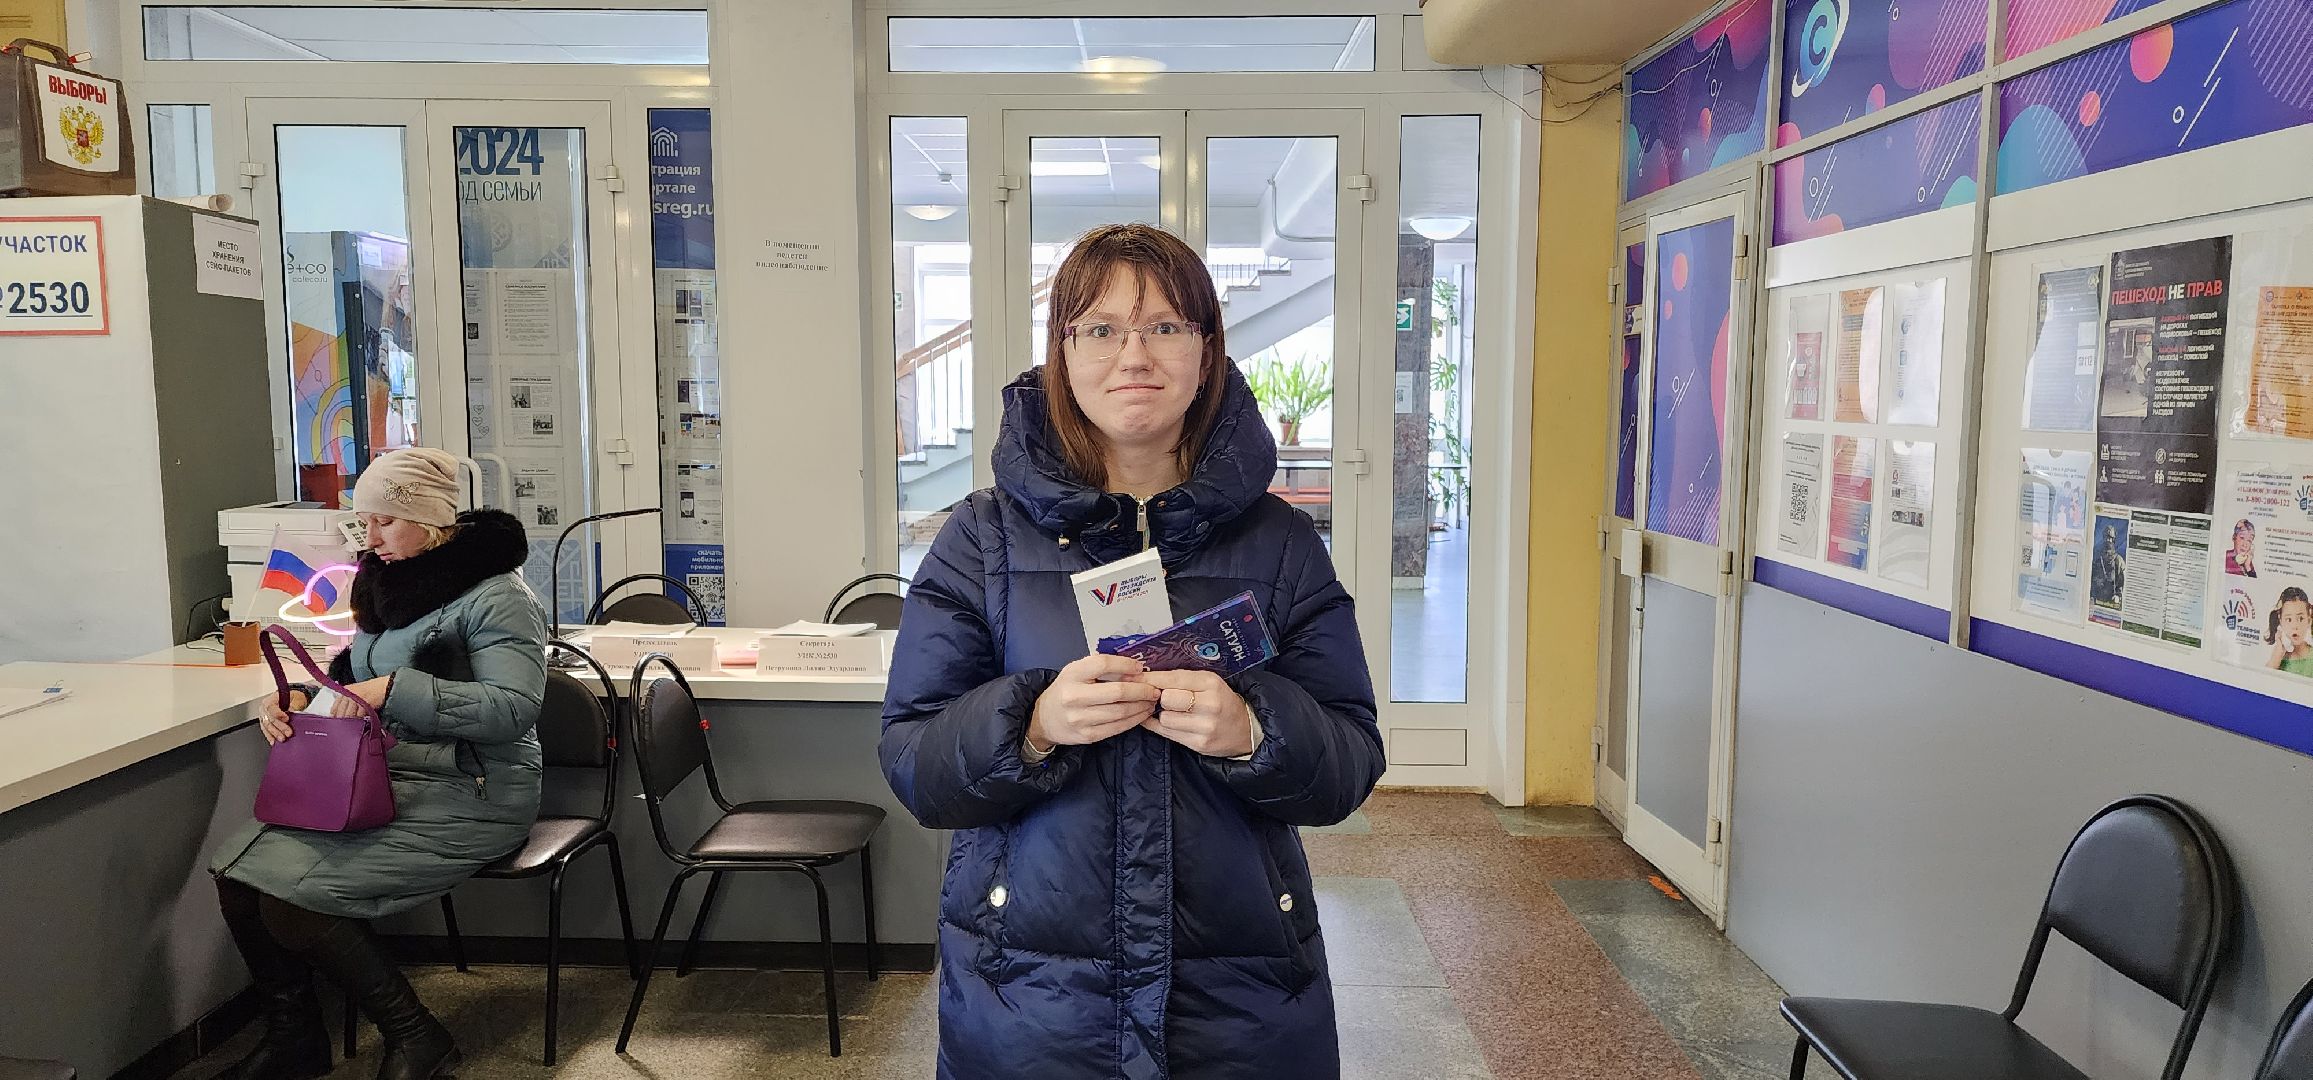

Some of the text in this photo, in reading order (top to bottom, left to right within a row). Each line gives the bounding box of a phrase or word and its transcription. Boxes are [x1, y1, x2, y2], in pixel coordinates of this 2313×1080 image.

[48, 74, 107, 105] ВЫБОРЫ
[459, 128, 544, 175] 2024
[482, 180, 542, 201] семьи
[0, 235, 87, 253] ЧАСТОК
[217, 240, 239, 252] МЕСТО
[212, 250, 245, 264] ХРАНЕНИЯ
[756, 261, 829, 272] видеонаблюдение
[2111, 279, 2223, 305] ПЕШЕХОД НЕ ПРАВ
[1220, 620, 1247, 661] САТУРН
